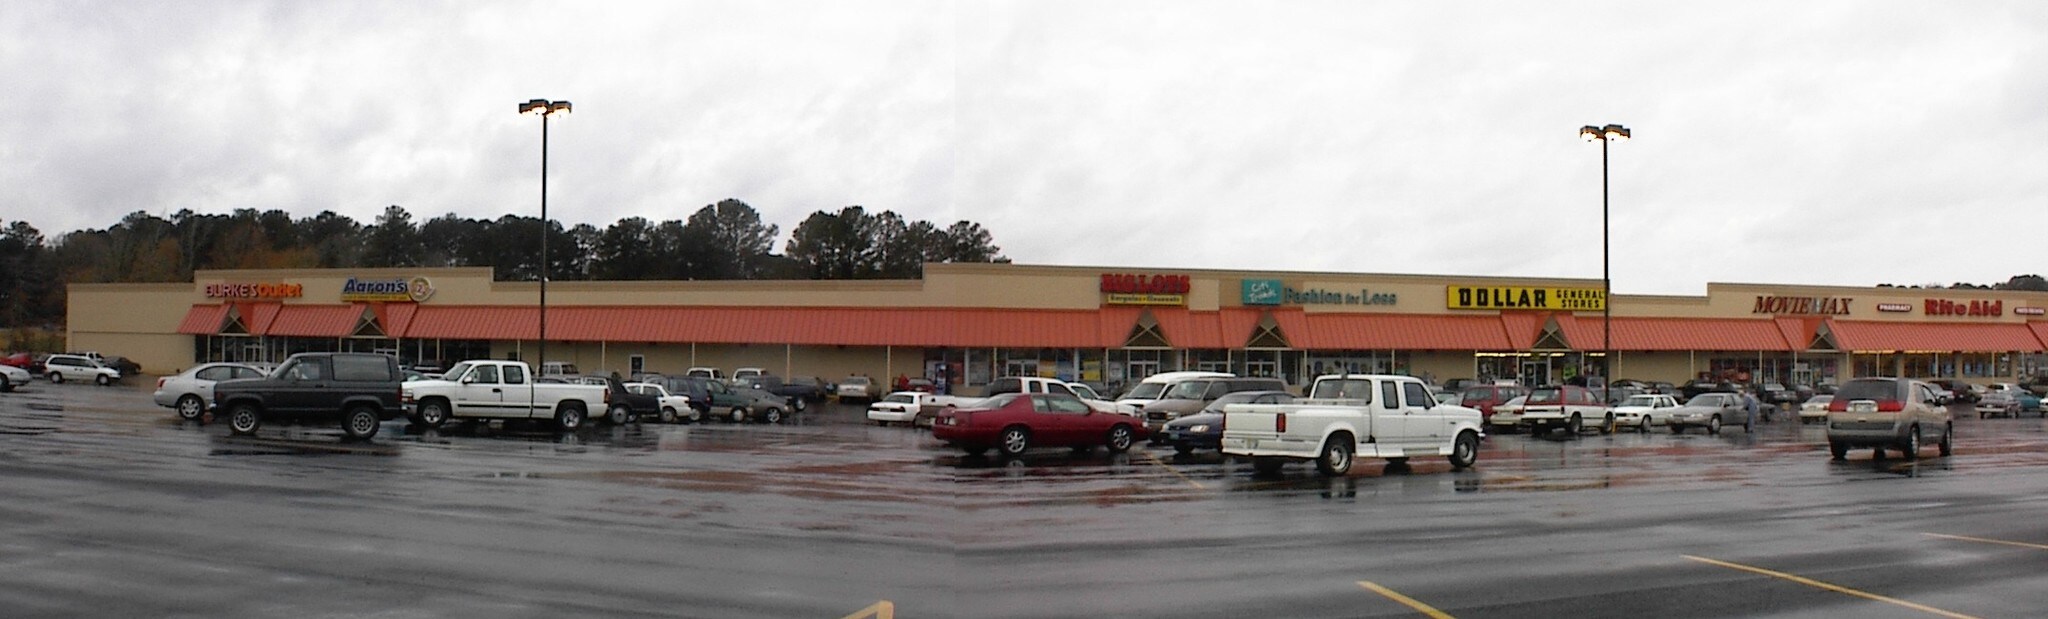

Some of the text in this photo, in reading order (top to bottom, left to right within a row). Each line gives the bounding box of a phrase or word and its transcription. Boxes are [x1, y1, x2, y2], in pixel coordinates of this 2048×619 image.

[258, 283, 302, 297] Outlet
[343, 278, 408, 293] Aaron's
[1285, 287, 1342, 305] Fashion
[1458, 288, 1547, 307] DOLLAR
[1556, 290, 1604, 299] GENERAL
[1561, 299, 1600, 308] STORES
[1924, 299, 2002, 316] Rite Aid
